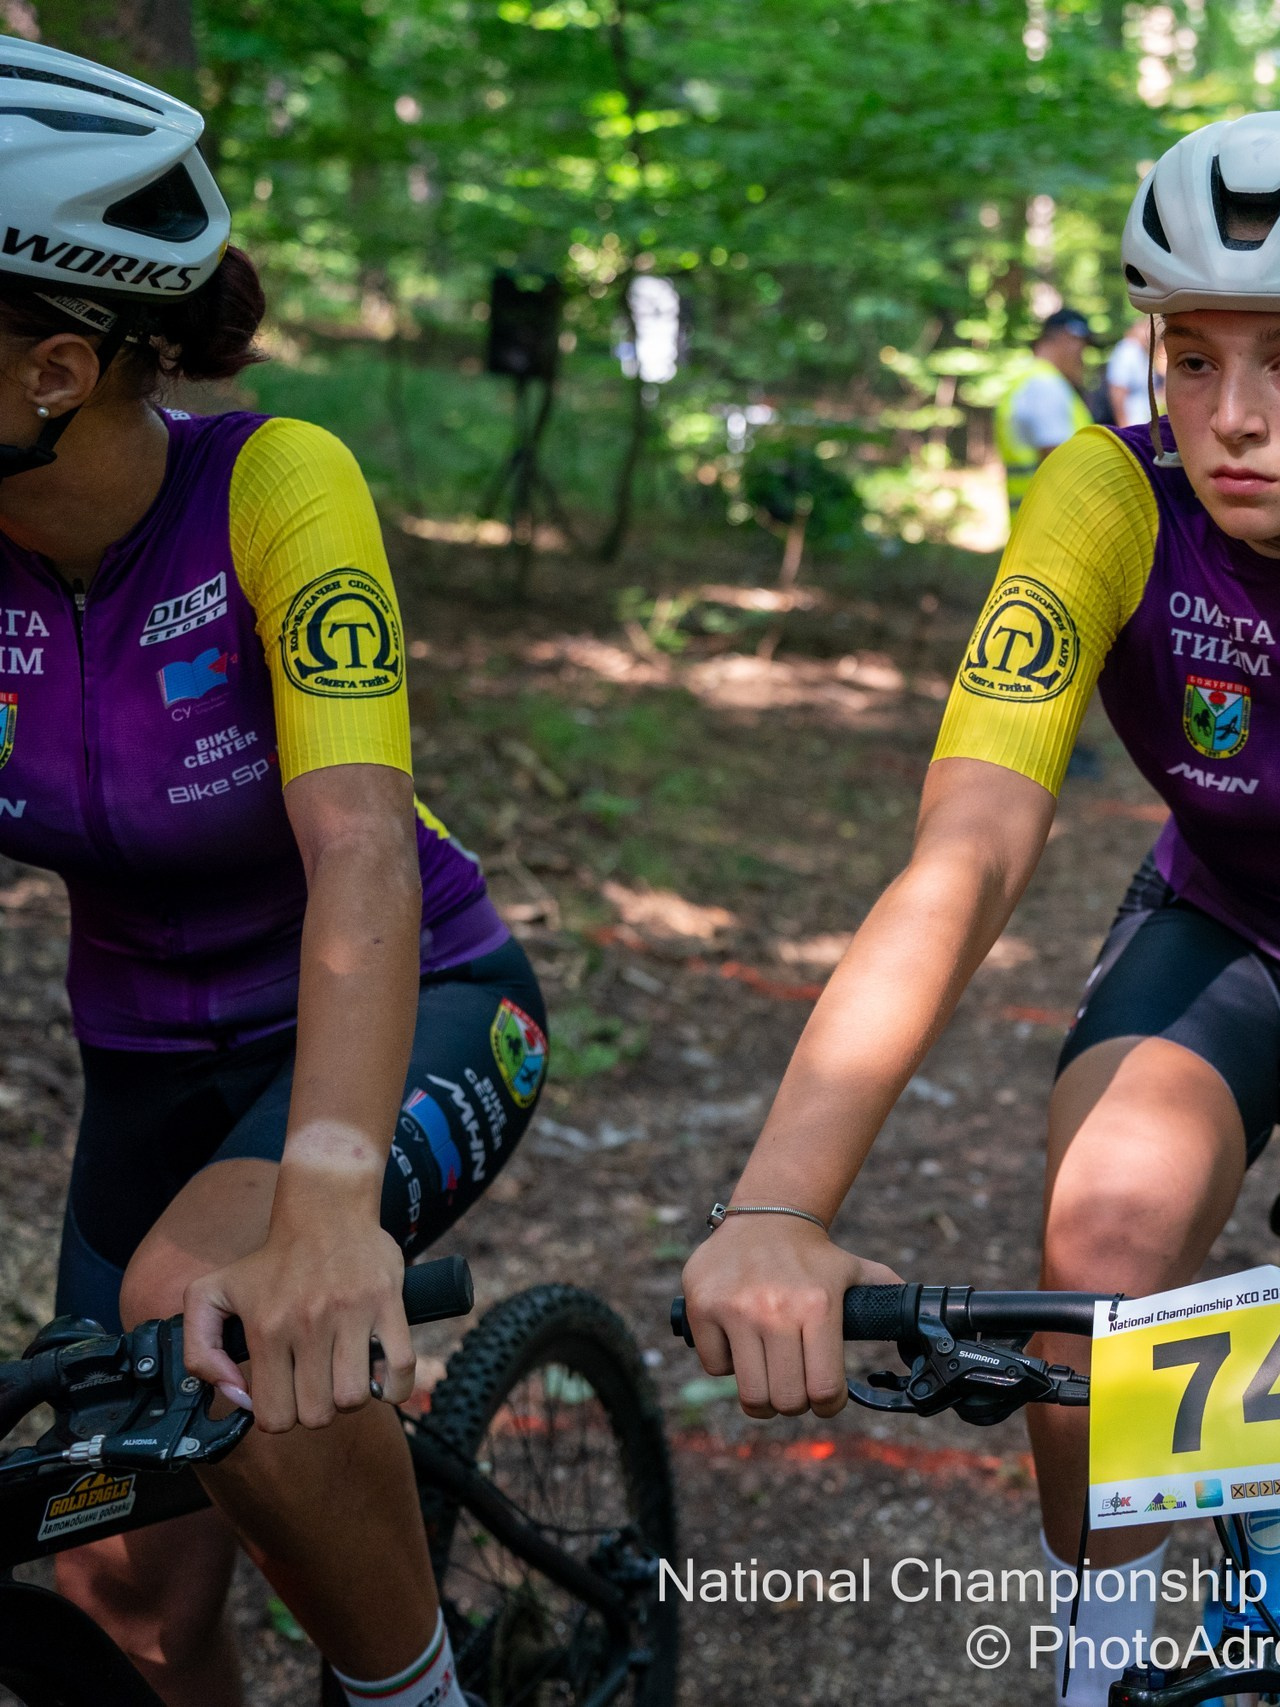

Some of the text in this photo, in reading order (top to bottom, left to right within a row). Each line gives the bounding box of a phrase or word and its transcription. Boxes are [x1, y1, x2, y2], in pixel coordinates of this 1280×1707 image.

[2, 227, 200, 290] WORKS
[147, 577, 223, 626] DIEM
[0, 608, 50, 637] ГА
[146, 608, 222, 644] SPORT
[184, 731, 258, 768] CENTER
[195, 725, 241, 752] BIKE
[168, 778, 230, 804] Bike
[1109, 1313, 1154, 1332] National
[1157, 1298, 1232, 1322] Championship
[1236, 1292, 1260, 1306] XCO
[959, 1350, 1000, 1365] SHIMANO
[50, 1481, 131, 1517] GOLD EAGLE
